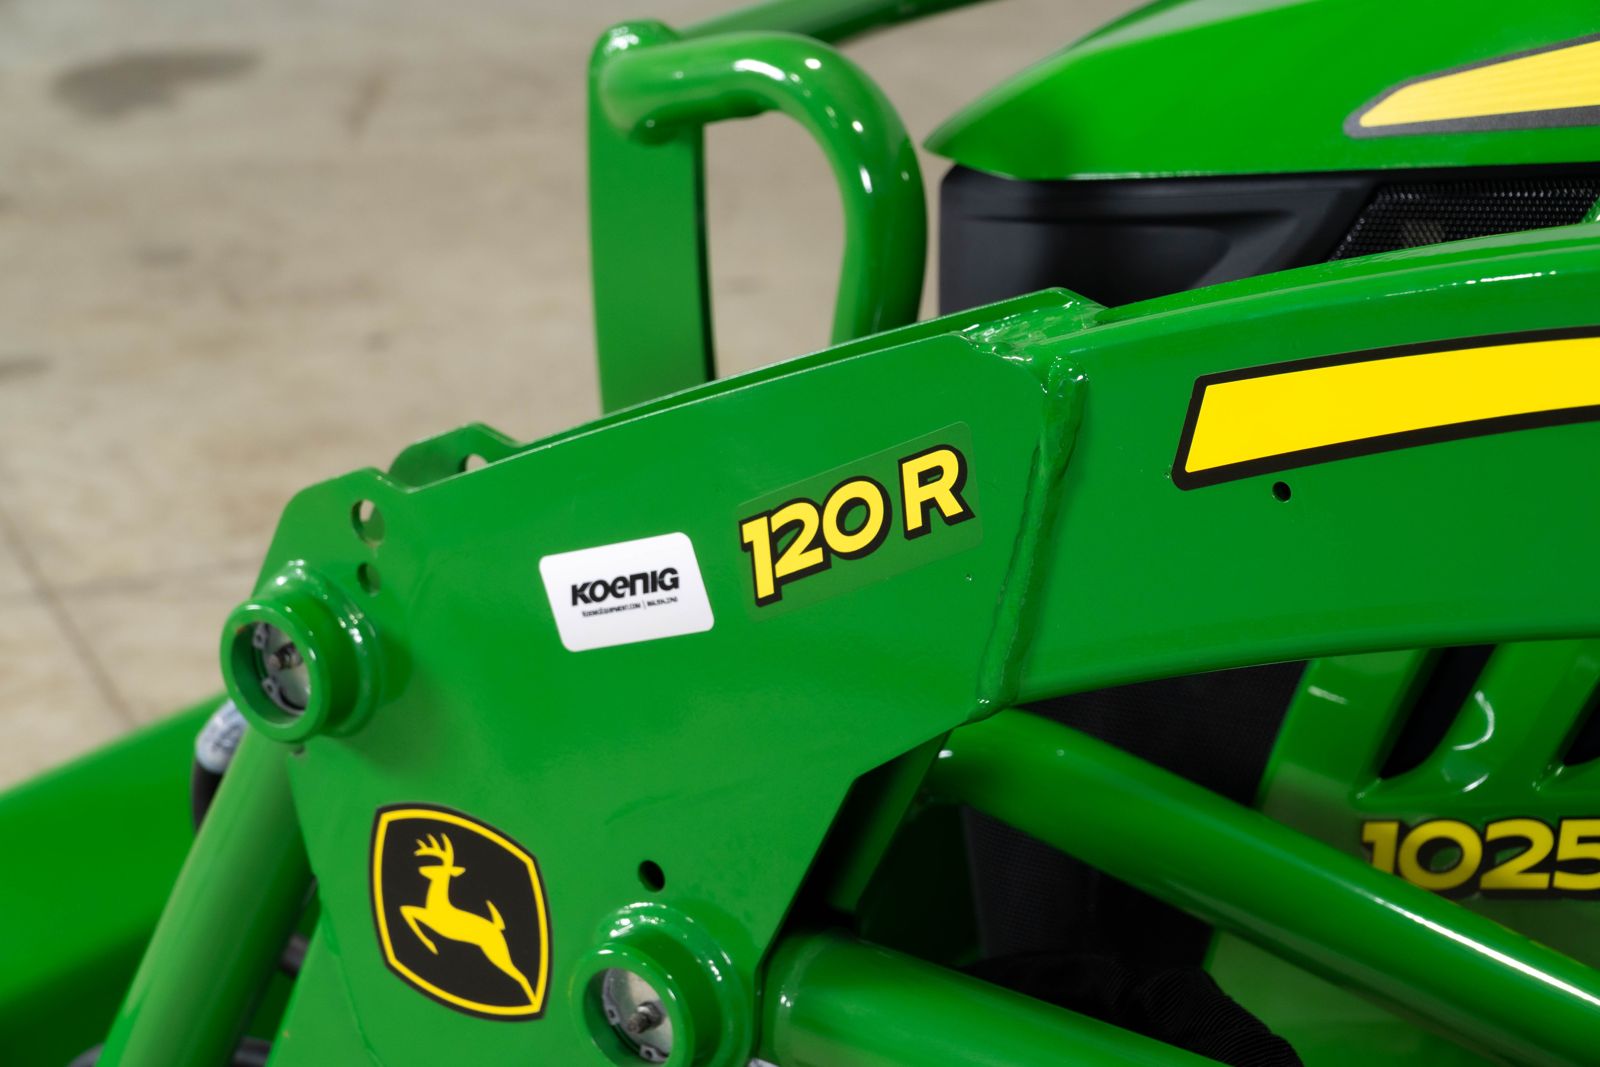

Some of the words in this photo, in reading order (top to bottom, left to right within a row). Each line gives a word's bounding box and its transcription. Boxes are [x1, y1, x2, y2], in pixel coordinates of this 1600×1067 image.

[738, 475, 893, 608] 120
[897, 443, 976, 541] R
[1361, 816, 1600, 900] 1025
